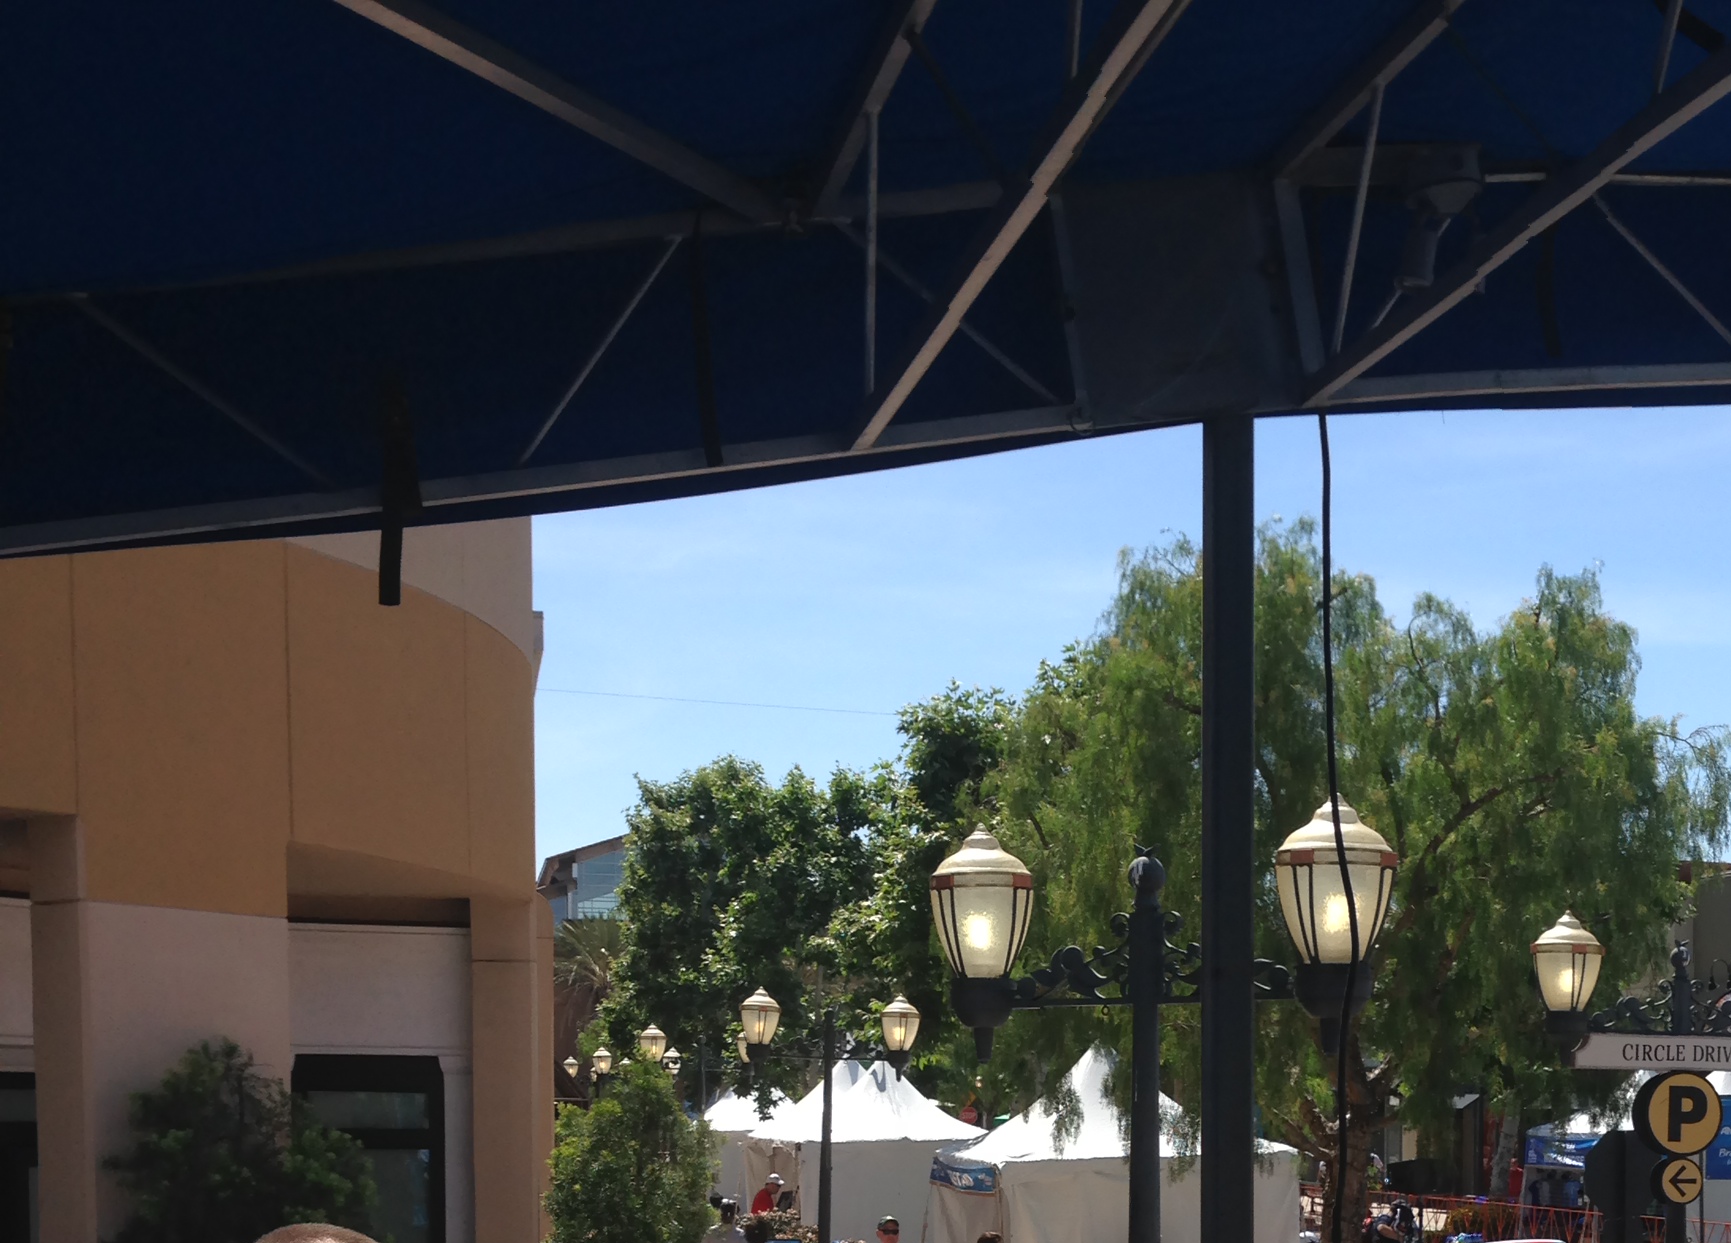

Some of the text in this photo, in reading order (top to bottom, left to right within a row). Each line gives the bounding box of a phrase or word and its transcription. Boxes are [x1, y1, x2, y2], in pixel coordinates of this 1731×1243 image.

[1622, 1043, 1686, 1062] CIRCLE
[961, 1110, 976, 1120] STOP
[1667, 1086, 1708, 1142] P
